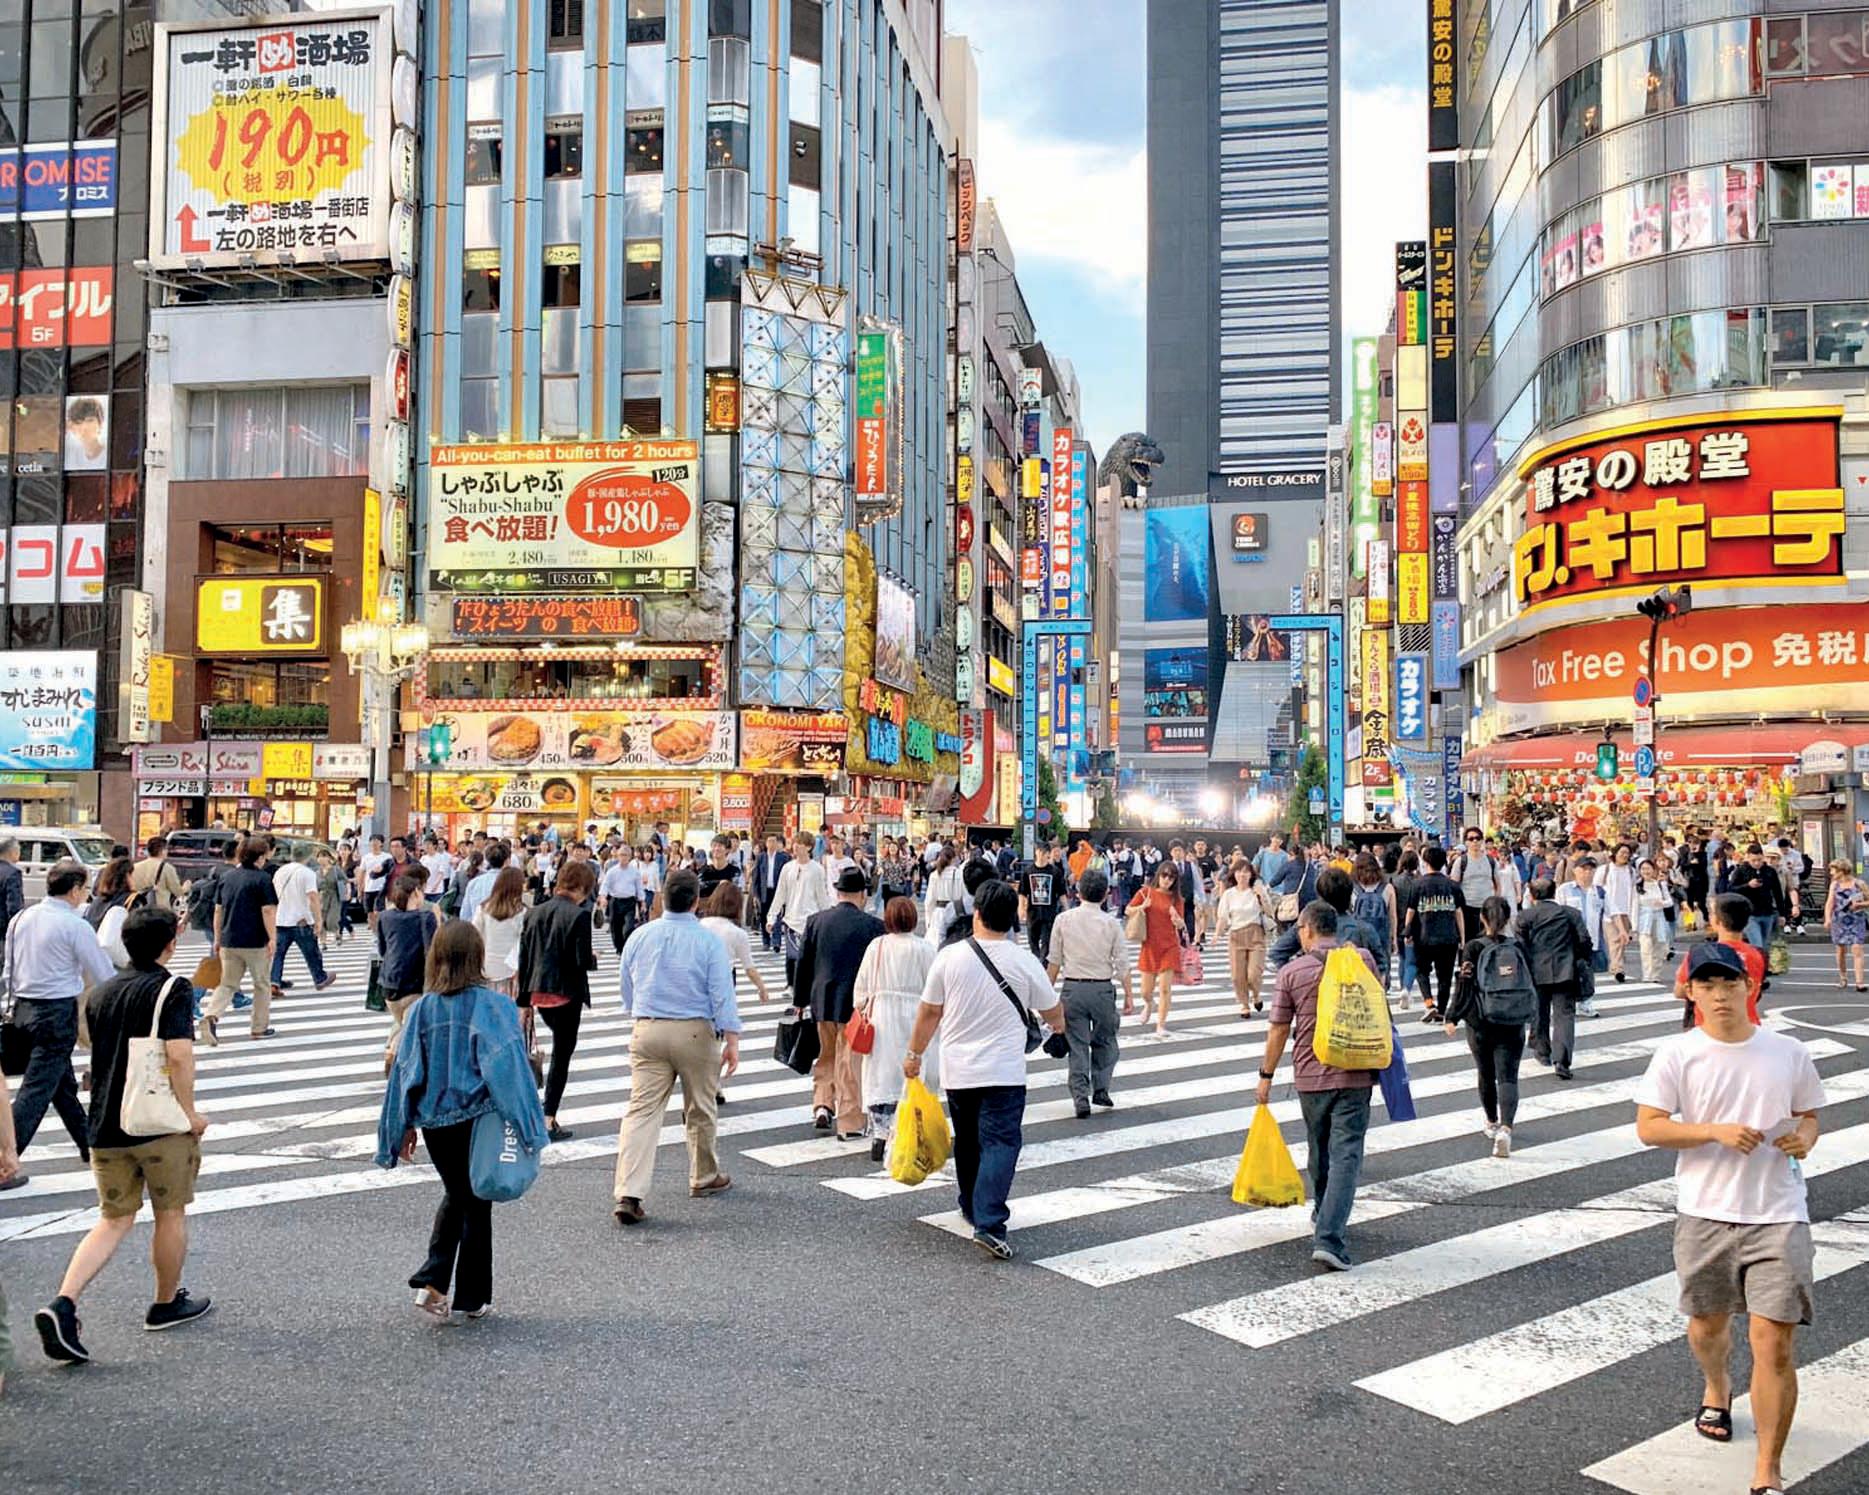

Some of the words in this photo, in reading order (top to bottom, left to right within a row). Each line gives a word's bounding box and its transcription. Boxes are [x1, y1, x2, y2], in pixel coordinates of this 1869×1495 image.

[180, 30, 371, 74] 一軒め酒場
[208, 105, 350, 170] 190円
[215, 223, 358, 251] 左の路地を右へ
[31, 327, 54, 342] 5F
[437, 448, 551, 464] All-you-can-eat
[556, 445, 601, 460] buffet
[605, 444, 628, 459] for
[633, 444, 643, 459] 2
[648, 443, 693, 458] hours
[1533, 432, 1750, 513] 驚安の殿堂
[440, 470, 564, 495] しゃぶしゃぶ
[1228, 476, 1266, 487] HOTEL
[1267, 474, 1321, 486] GRACERY
[444, 515, 558, 543] 食べ放題!
[583, 500, 659, 539] 1,980
[660, 522, 680, 533] yen
[0, 537, 105, 578] コム
[262, 588, 312, 640] 集
[469, 618, 529, 633] スイーツ
[542, 618, 558, 632] の
[1531, 658, 1557, 690] Tax
[1562, 650, 1624, 683] Free
[1638, 635, 1754, 679] Shop
[1771, 631, 1869, 668] 免税
[1400, 660, 1420, 736] カラオケ
[746, 714, 813, 728] OKONOMI
[817, 715, 848, 729] YAKI
[1447, 740, 1460, 799] カラオケ
[1424, 776, 1438, 824] カラオケ
